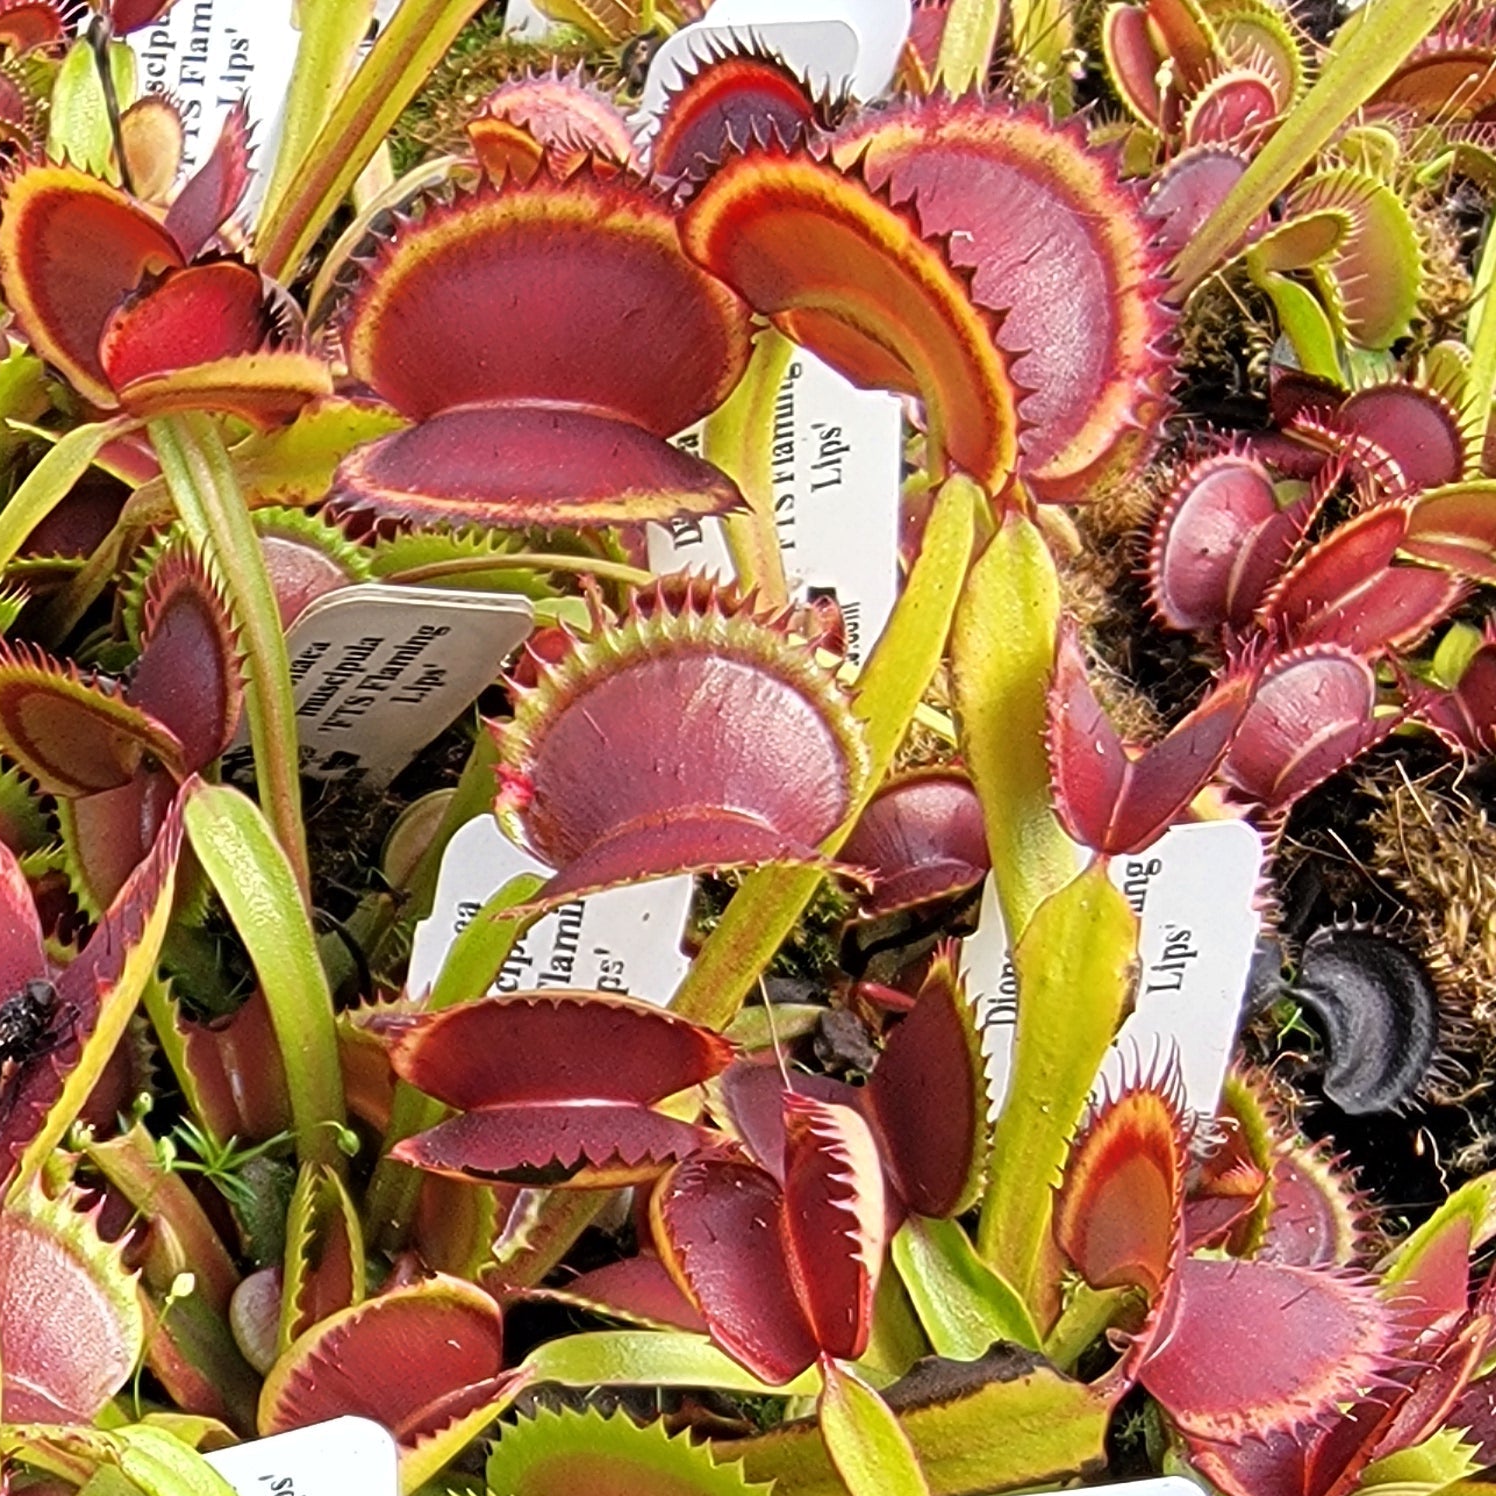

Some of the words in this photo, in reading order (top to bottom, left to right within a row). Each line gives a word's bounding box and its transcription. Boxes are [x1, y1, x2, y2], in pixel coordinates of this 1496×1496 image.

[810, 423, 851, 493] Lips'
[295, 635, 386, 717] muscipula
[317, 695, 375, 733] 'FTS
[357, 624, 452, 692] Flaming
[390, 663, 447, 704] Lips'
[1146, 923, 1199, 993] Lips'
